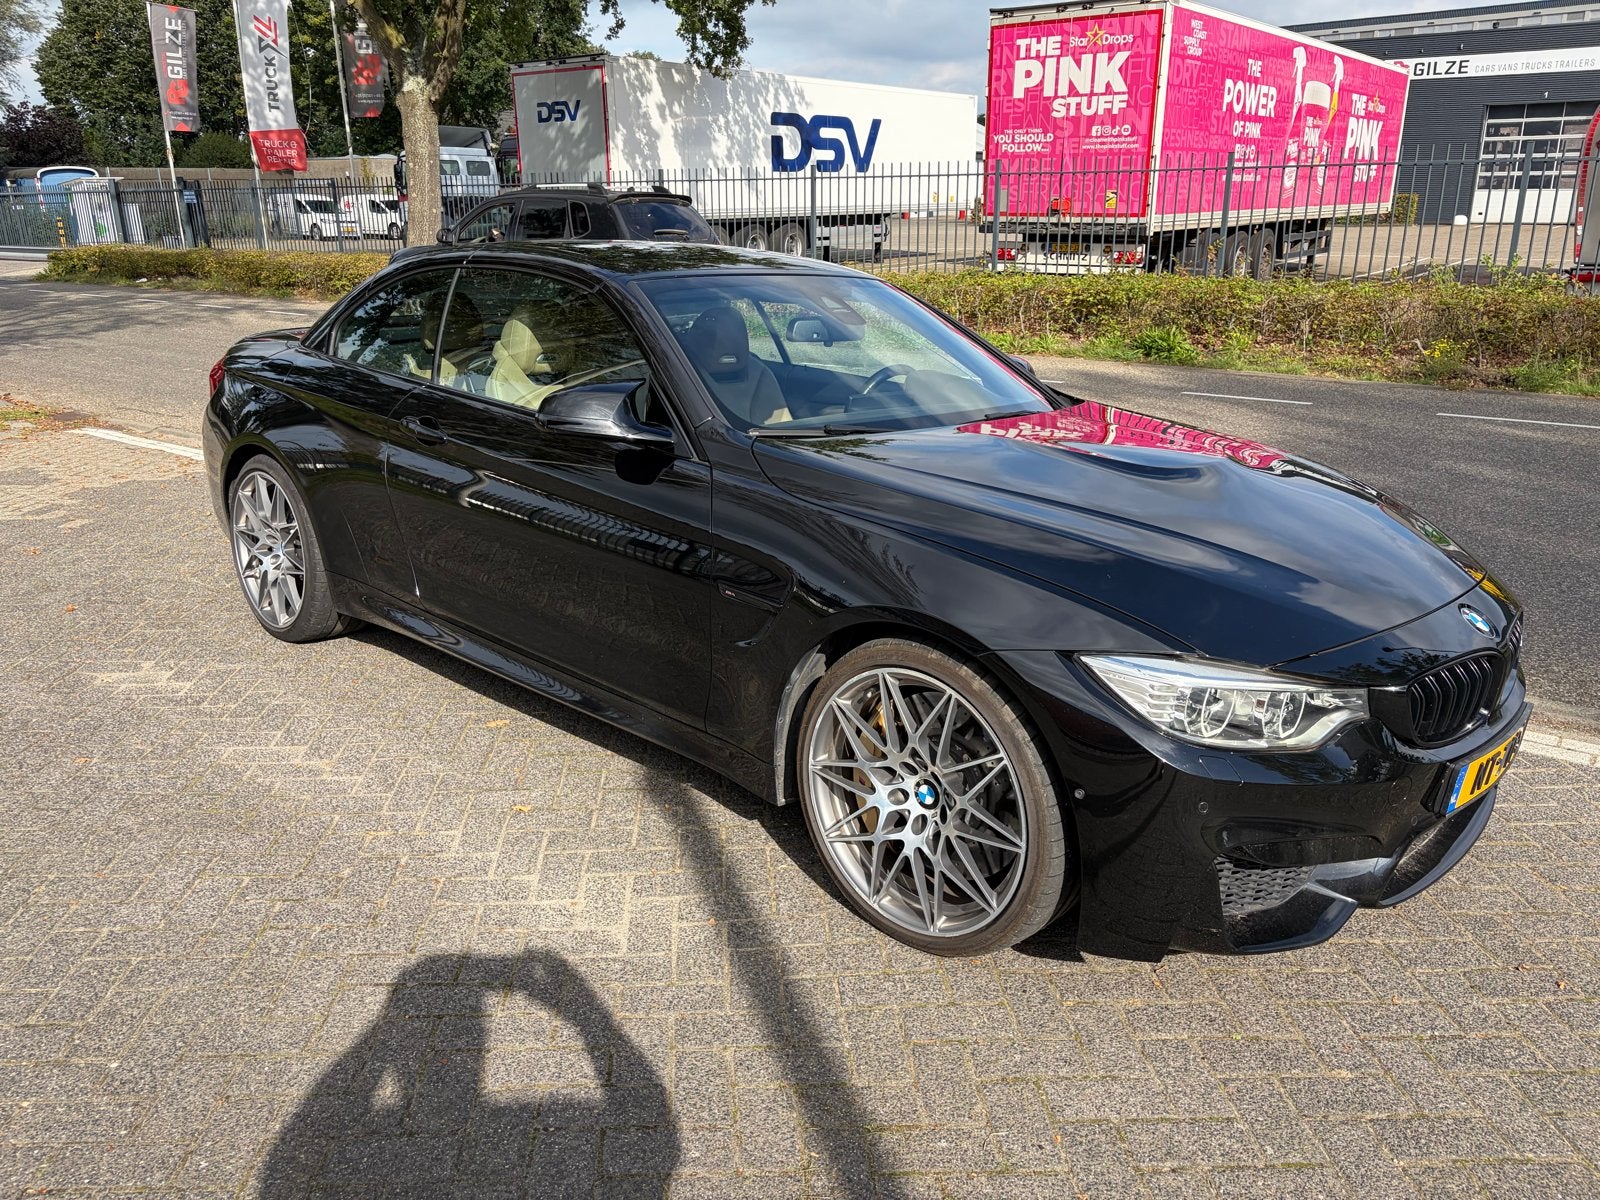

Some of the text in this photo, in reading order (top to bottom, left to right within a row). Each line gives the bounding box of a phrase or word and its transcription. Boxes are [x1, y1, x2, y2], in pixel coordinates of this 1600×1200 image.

[1191, 19, 1204, 29] WEST
[1070, 33, 1134, 48] Star Drops
[1183, 36, 1201, 47] SUPPLY
[1193, 29, 1207, 40] COAST
[165, 17, 183, 79] GILZE
[1016, 35, 1063, 58] THE
[1187, 46, 1202, 57] GROUP
[1013, 51, 1132, 99] PINK
[1247, 59, 1262, 78] THE
[1413, 59, 1470, 77] GILZE
[1475, 64, 1496, 74] CARS
[1498, 62, 1518, 72] VANS
[1521, 60, 1553, 71] TRUCKS
[1555, 58, 1597, 69] TRAILERS
[264, 55, 281, 112] TRUCK
[1222, 78, 1278, 118] POWER
[1543, 91, 1549, 99] 1
[536, 99, 581, 124] DSV
[1051, 94, 1129, 118] STUFF
[1352, 93, 1367, 117] THE
[993, 133, 1054, 144] YOU SHOULD
[1233, 121, 1262, 138] OF PINK
[1303, 127, 1321, 147] PINK
[1343, 116, 1384, 161] PINK
[259, 138, 288, 148] TRUCK
[770, 111, 882, 173] DSV
[1002, 143, 1049, 153] FOLLOW...
[262, 147, 298, 158] TRAILER
[268, 156, 297, 166] REIR
